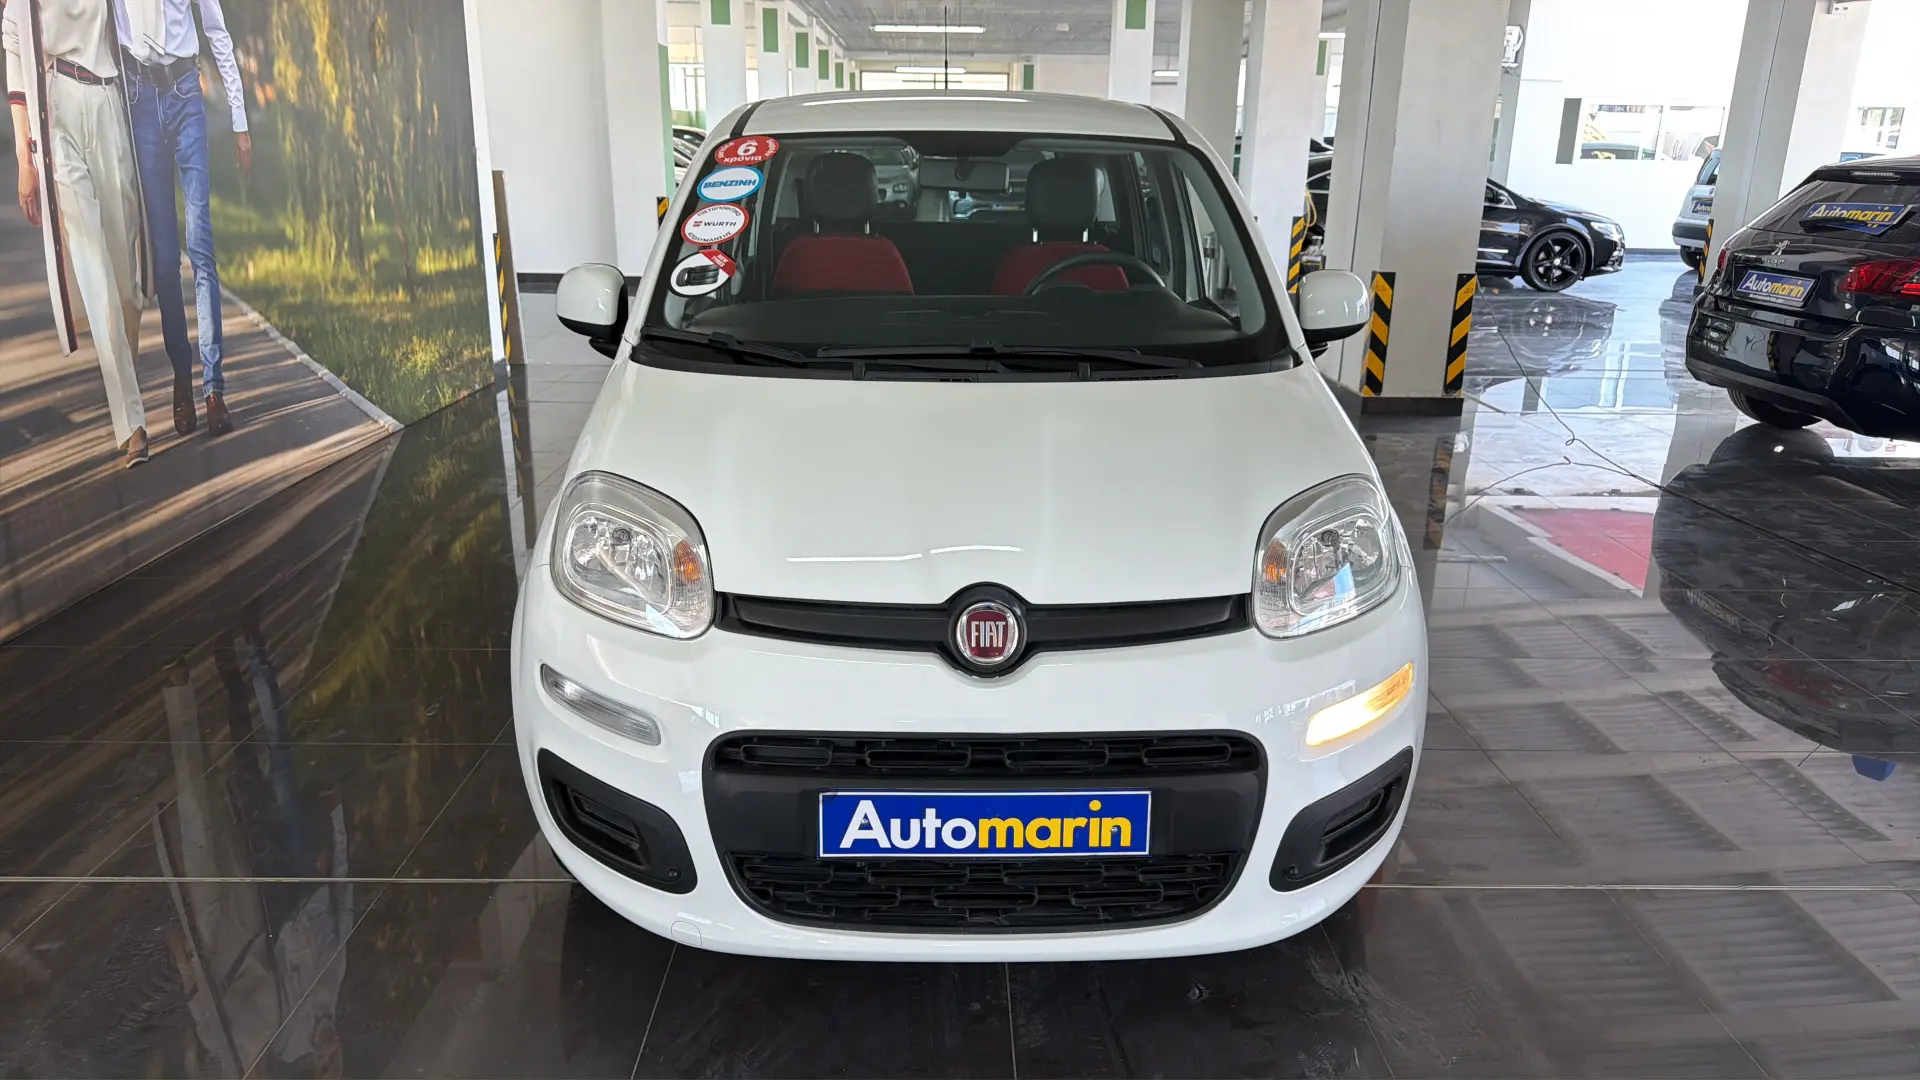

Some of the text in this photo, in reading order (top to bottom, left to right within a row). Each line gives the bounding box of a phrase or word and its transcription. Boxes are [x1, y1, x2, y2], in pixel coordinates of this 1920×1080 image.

[737, 142, 758, 156] 6
[1742, 274, 1804, 298] Automarin
[971, 621, 1006, 648] FIAT
[839, 799, 1131, 849] Automarin
